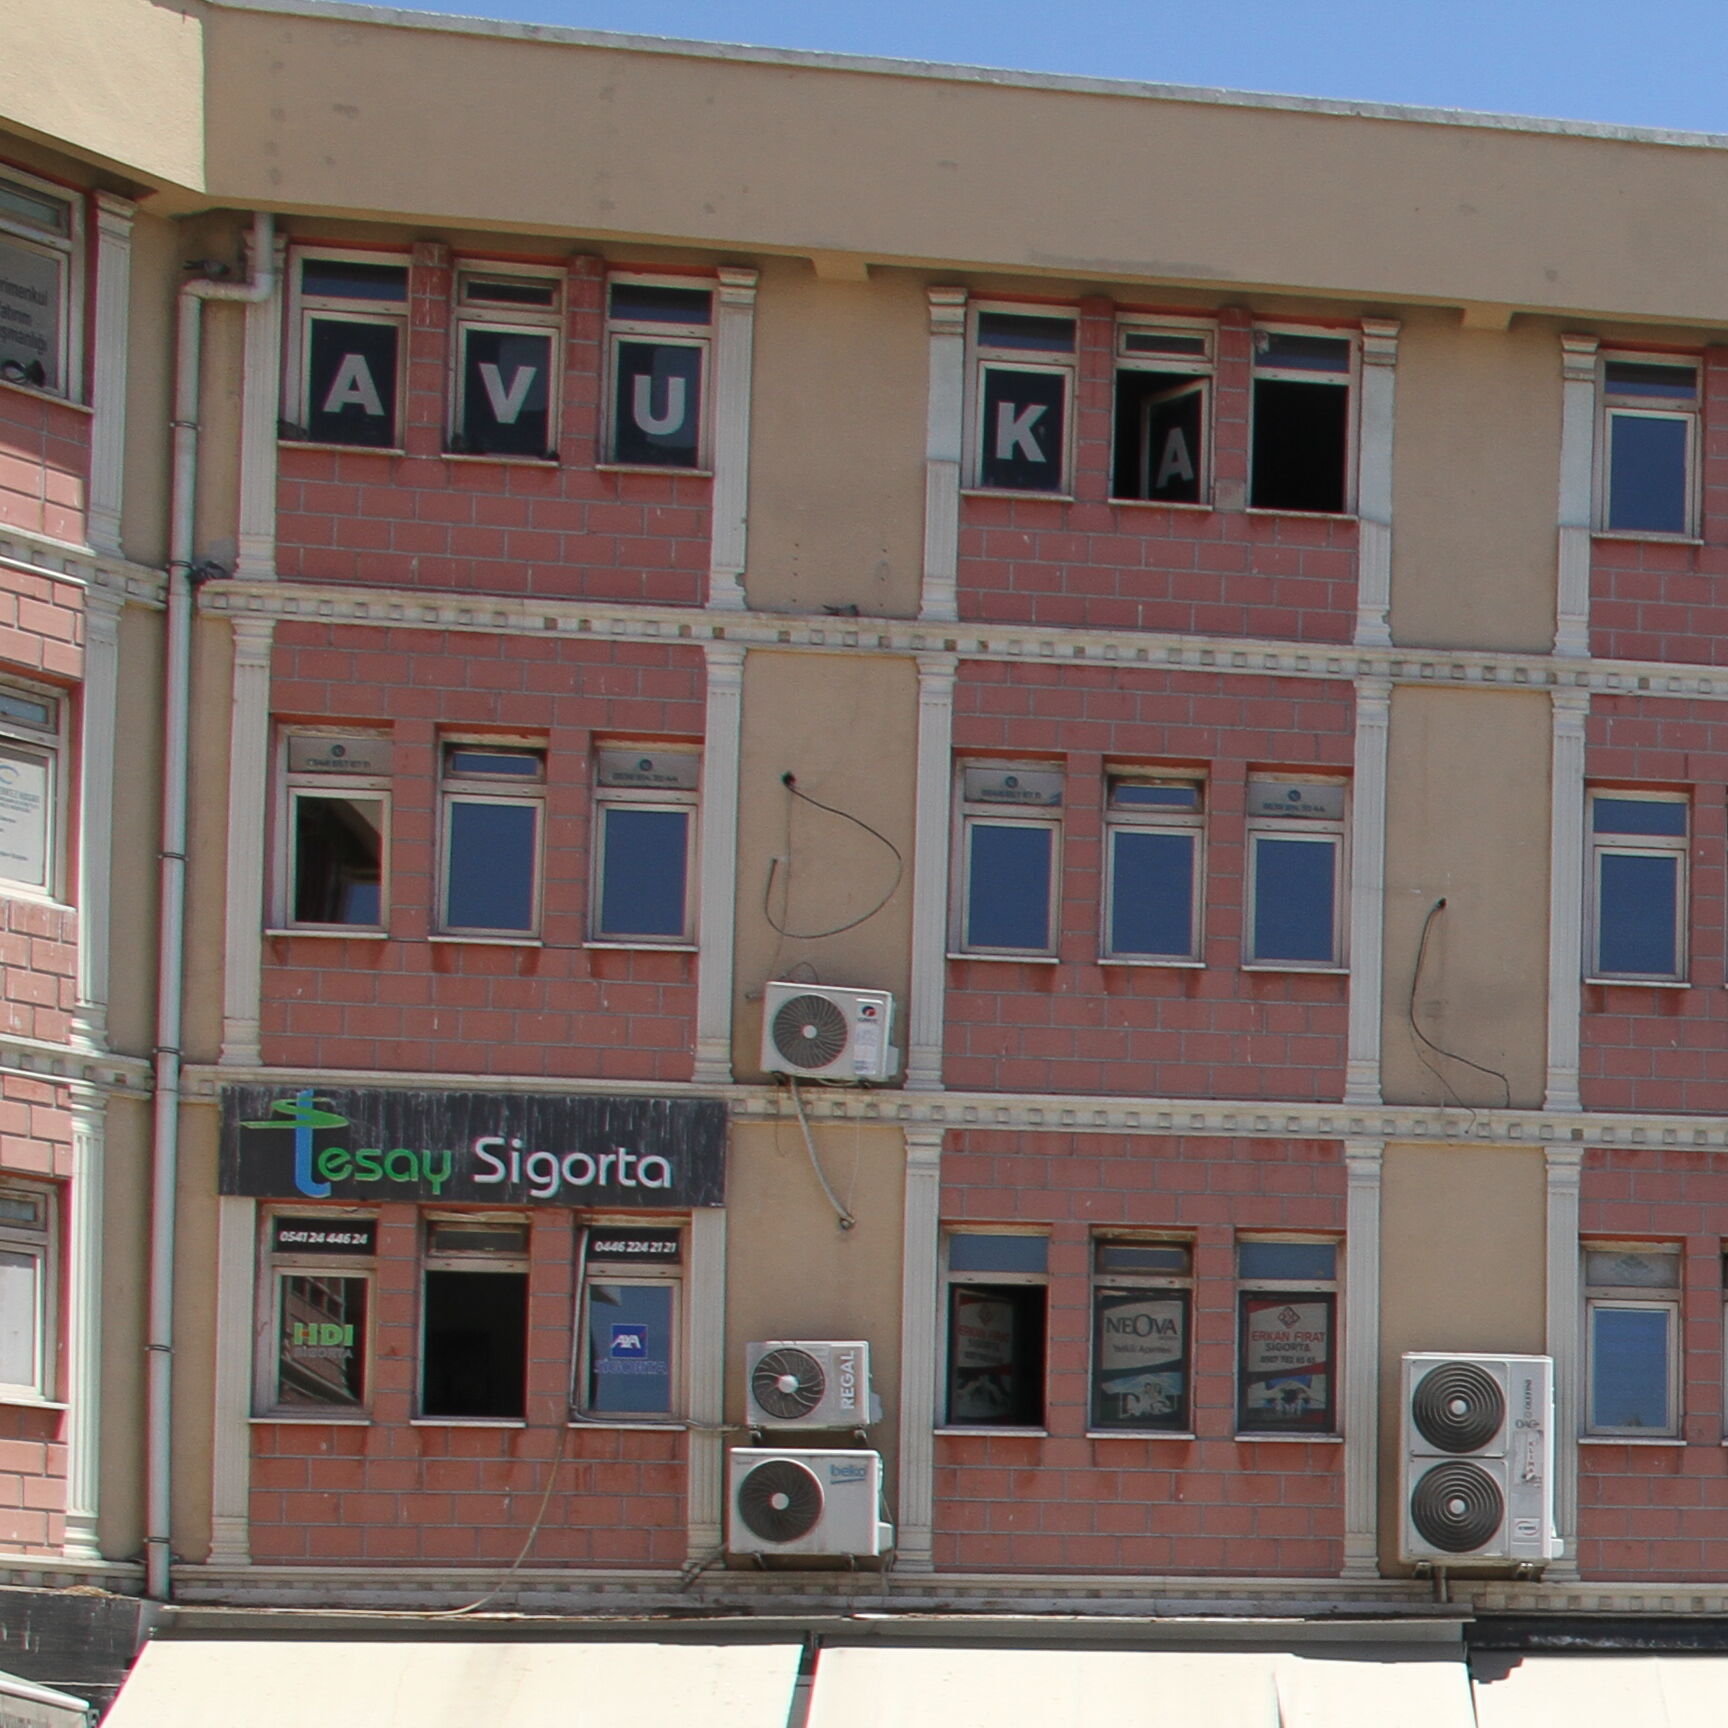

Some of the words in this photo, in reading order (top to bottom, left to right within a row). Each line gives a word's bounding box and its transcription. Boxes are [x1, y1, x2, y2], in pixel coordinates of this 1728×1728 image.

[323, 354, 385, 416] A
[479, 362, 537, 424] V
[633, 375, 687, 436] U
[996, 402, 1047, 463] K
[1156, 427, 1194, 489] A
[472, 1136, 672, 1199] Sigorta
[308, 1232, 325, 1244] 24
[351, 1233, 368, 1245] 24
[594, 1240, 626, 1253] 0446
[626, 1241, 650, 1253] 224
[650, 1242, 663, 1253] 21
[663, 1242, 677, 1253] 21
[294, 1322, 354, 1347] HDI
[1106, 1313, 1178, 1338] NEOVA
[1252, 1330, 1290, 1342] ERKAN
[611, 1334, 641, 1349] AXA
[840, 1351, 855, 1409] REGAL
